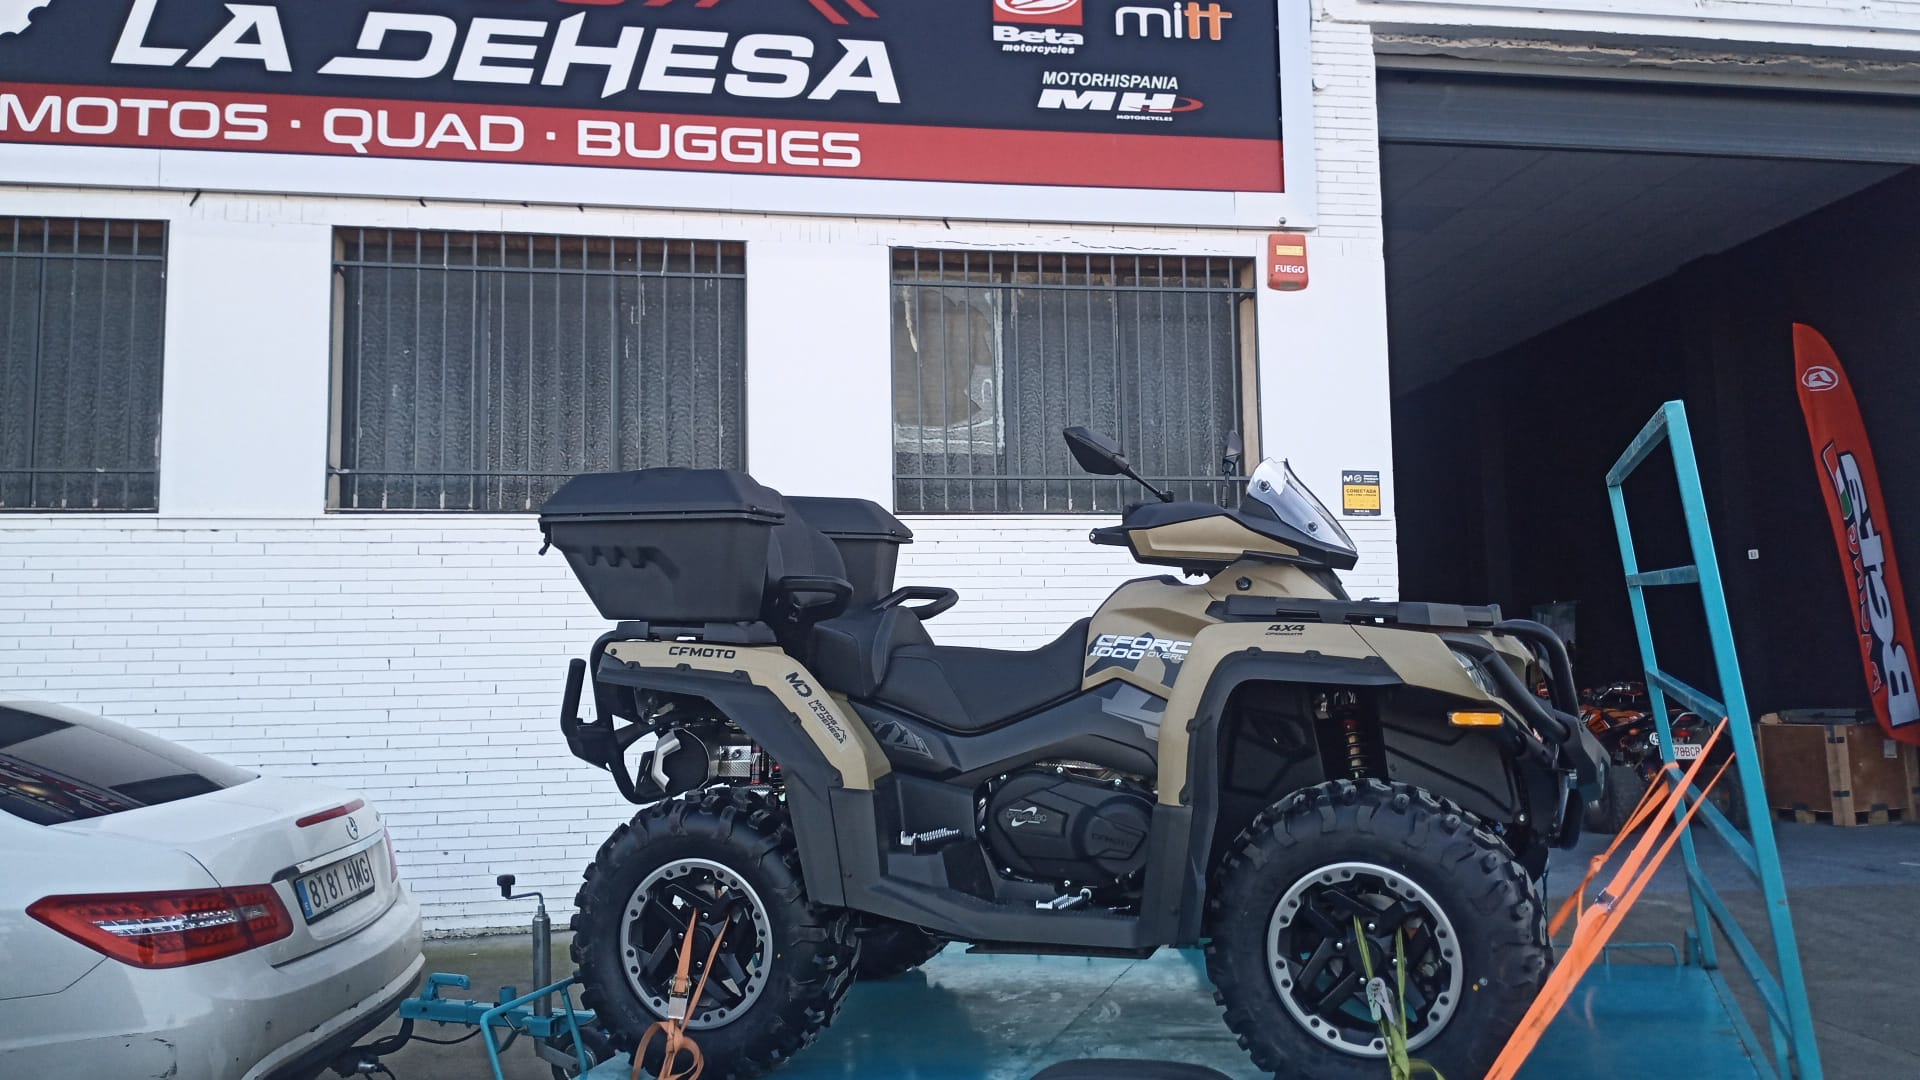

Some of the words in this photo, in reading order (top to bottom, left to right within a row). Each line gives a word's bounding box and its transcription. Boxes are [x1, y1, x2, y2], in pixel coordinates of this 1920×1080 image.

[1115, 1, 1232, 41] mitt
[993, 25, 1084, 46] Beta
[111, 0, 292, 72] LA
[317, 11, 901, 104] DEHESA
[1002, 43, 1075, 55] motorcycles
[1042, 71, 1179, 90] MOTORHISPANIA
[1037, 89, 1177, 113] MH
[1116, 114, 1173, 122] MOTORCYCLES
[0, 93, 268, 141] MOTOS
[323, 107, 525, 154] QUAD
[577, 119, 861, 168] BUGGIES
[1274, 264, 1305, 274] FUEGO
[1840, 453, 1920, 727] Beta
[668, 646, 737, 660] CFMOTO
[1089, 646, 1145, 660] 1000
[1147, 651, 1185, 661] OVERL
[1096, 634, 1193, 655] CFORC
[808, 700, 818, 713] LA
[813, 699, 838, 726] MOTOS
[308, 869, 344, 908] 8181
[343, 857, 370, 892] HMG
